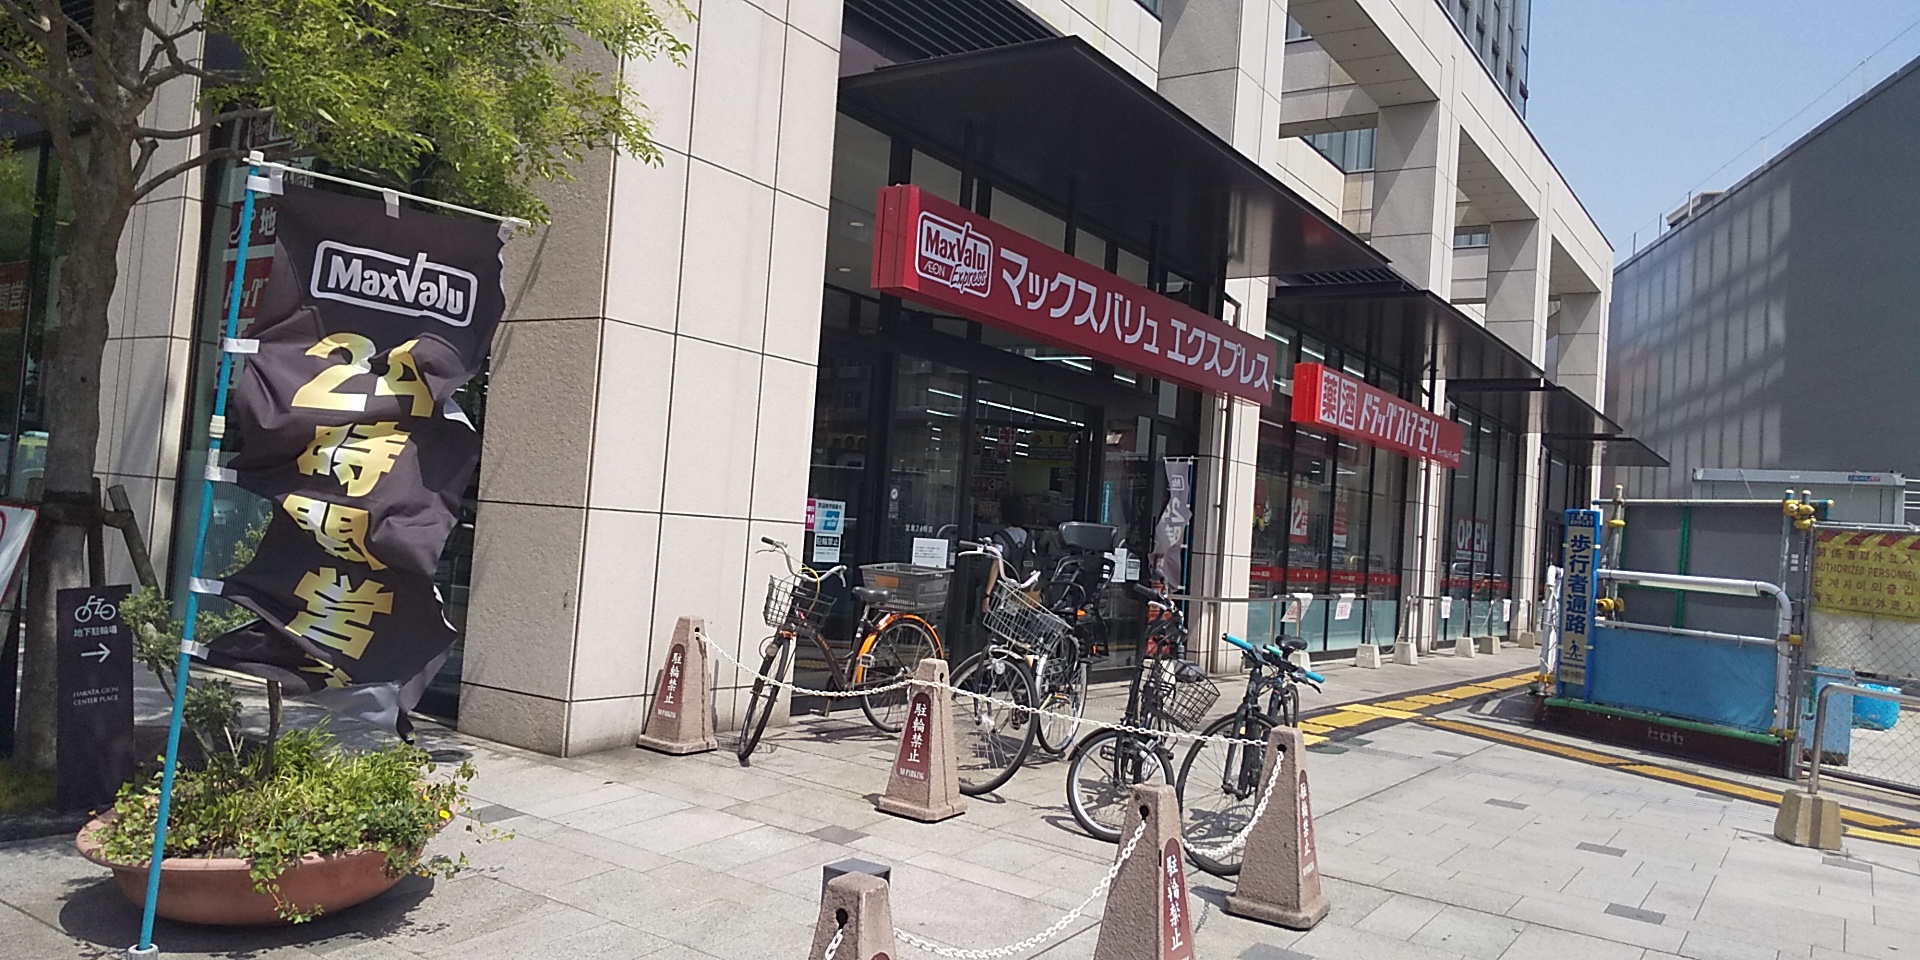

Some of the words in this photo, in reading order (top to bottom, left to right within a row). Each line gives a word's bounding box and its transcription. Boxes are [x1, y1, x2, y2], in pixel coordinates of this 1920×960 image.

[925, 224, 986, 271] MaxValu
[327, 252, 464, 315] MaxValu
[951, 263, 987, 292] Express
[1000, 247, 1159, 354] マックスバリュ
[1167, 318, 1269, 392] エクスプレス
[1321, 374, 1338, 421] 薬
[1341, 382, 1356, 428] 酒
[1358, 393, 1440, 455] ドラッグストアモリ
[1456, 519, 1488, 552] OPEN
[1565, 534, 1592, 635] 歩行者通路
[1815, 562, 1865, 576] AUTHORIZED
[1867, 567, 1918, 581] PERSONNEL
[73, 625, 118, 638] 地下駐輪場
[73, 688, 100, 698] HAKATA
[101, 686, 119, 694] GION
[73, 697, 99, 706] CENTER
[99, 694, 119, 703] PLACE
[664, 652, 683, 705] 駐輪禁止
[907, 702, 927, 763] 駐輪禁止
[1166, 854, 1184, 951] 駐輪禁止
